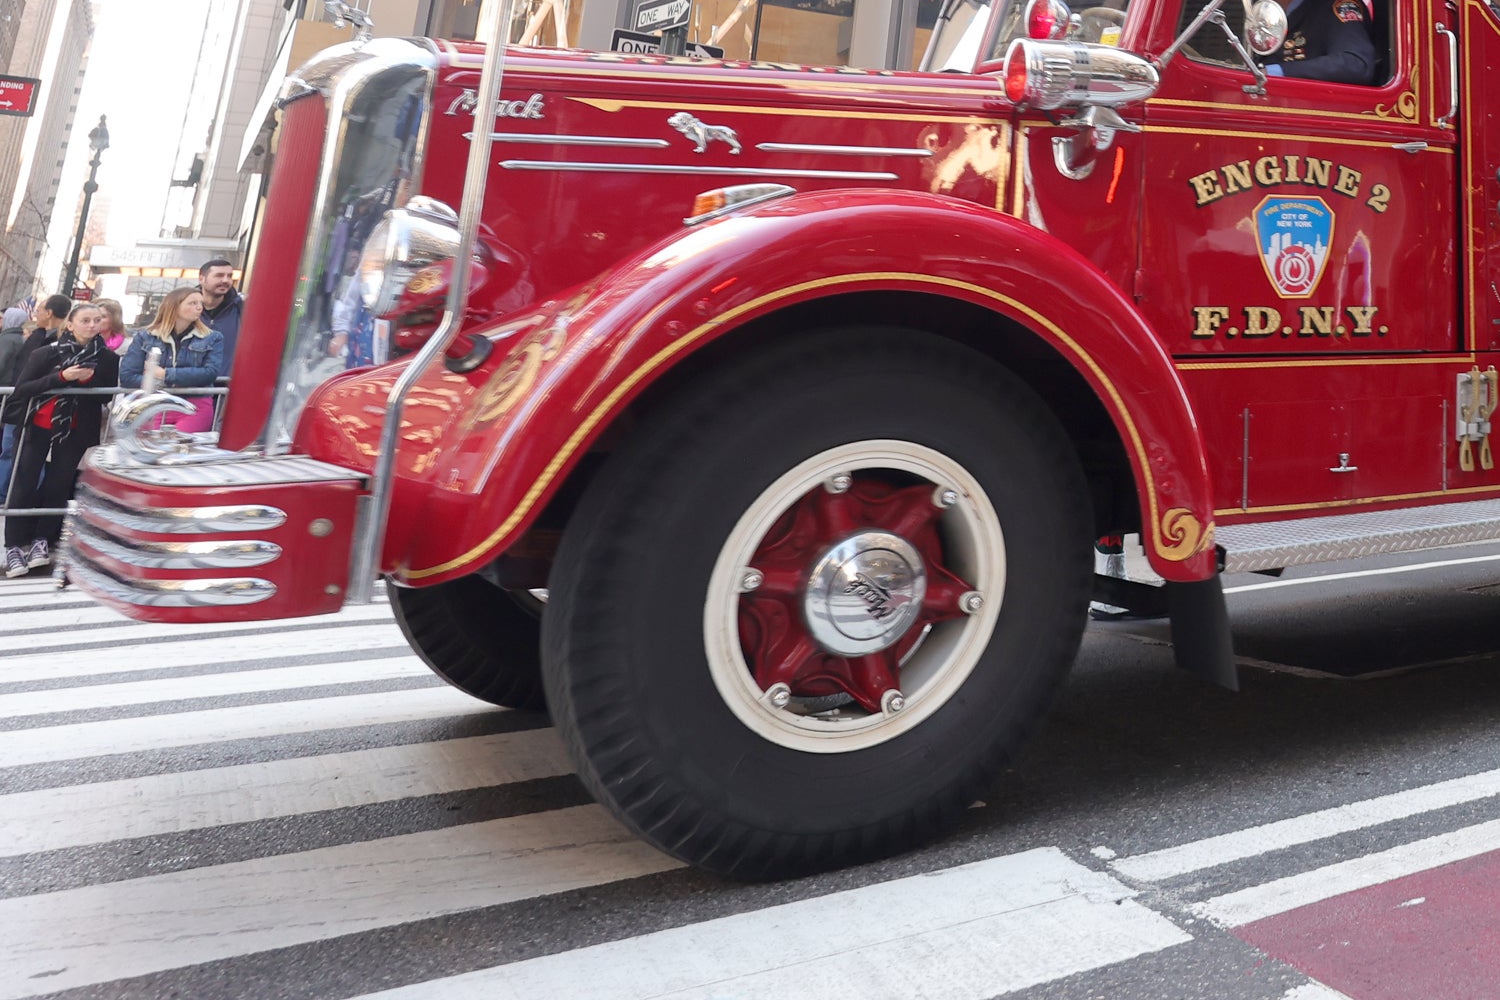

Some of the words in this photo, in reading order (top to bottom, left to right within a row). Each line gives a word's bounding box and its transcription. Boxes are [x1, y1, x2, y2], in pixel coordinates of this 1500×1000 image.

[640, 9, 659, 25] ONE
[667, 0, 685, 17] WAY
[1189, 156, 1362, 205] ENGINE
[1366, 184, 1391, 212] 2
[1193, 306, 1389, 335] F.D.N.Y.
